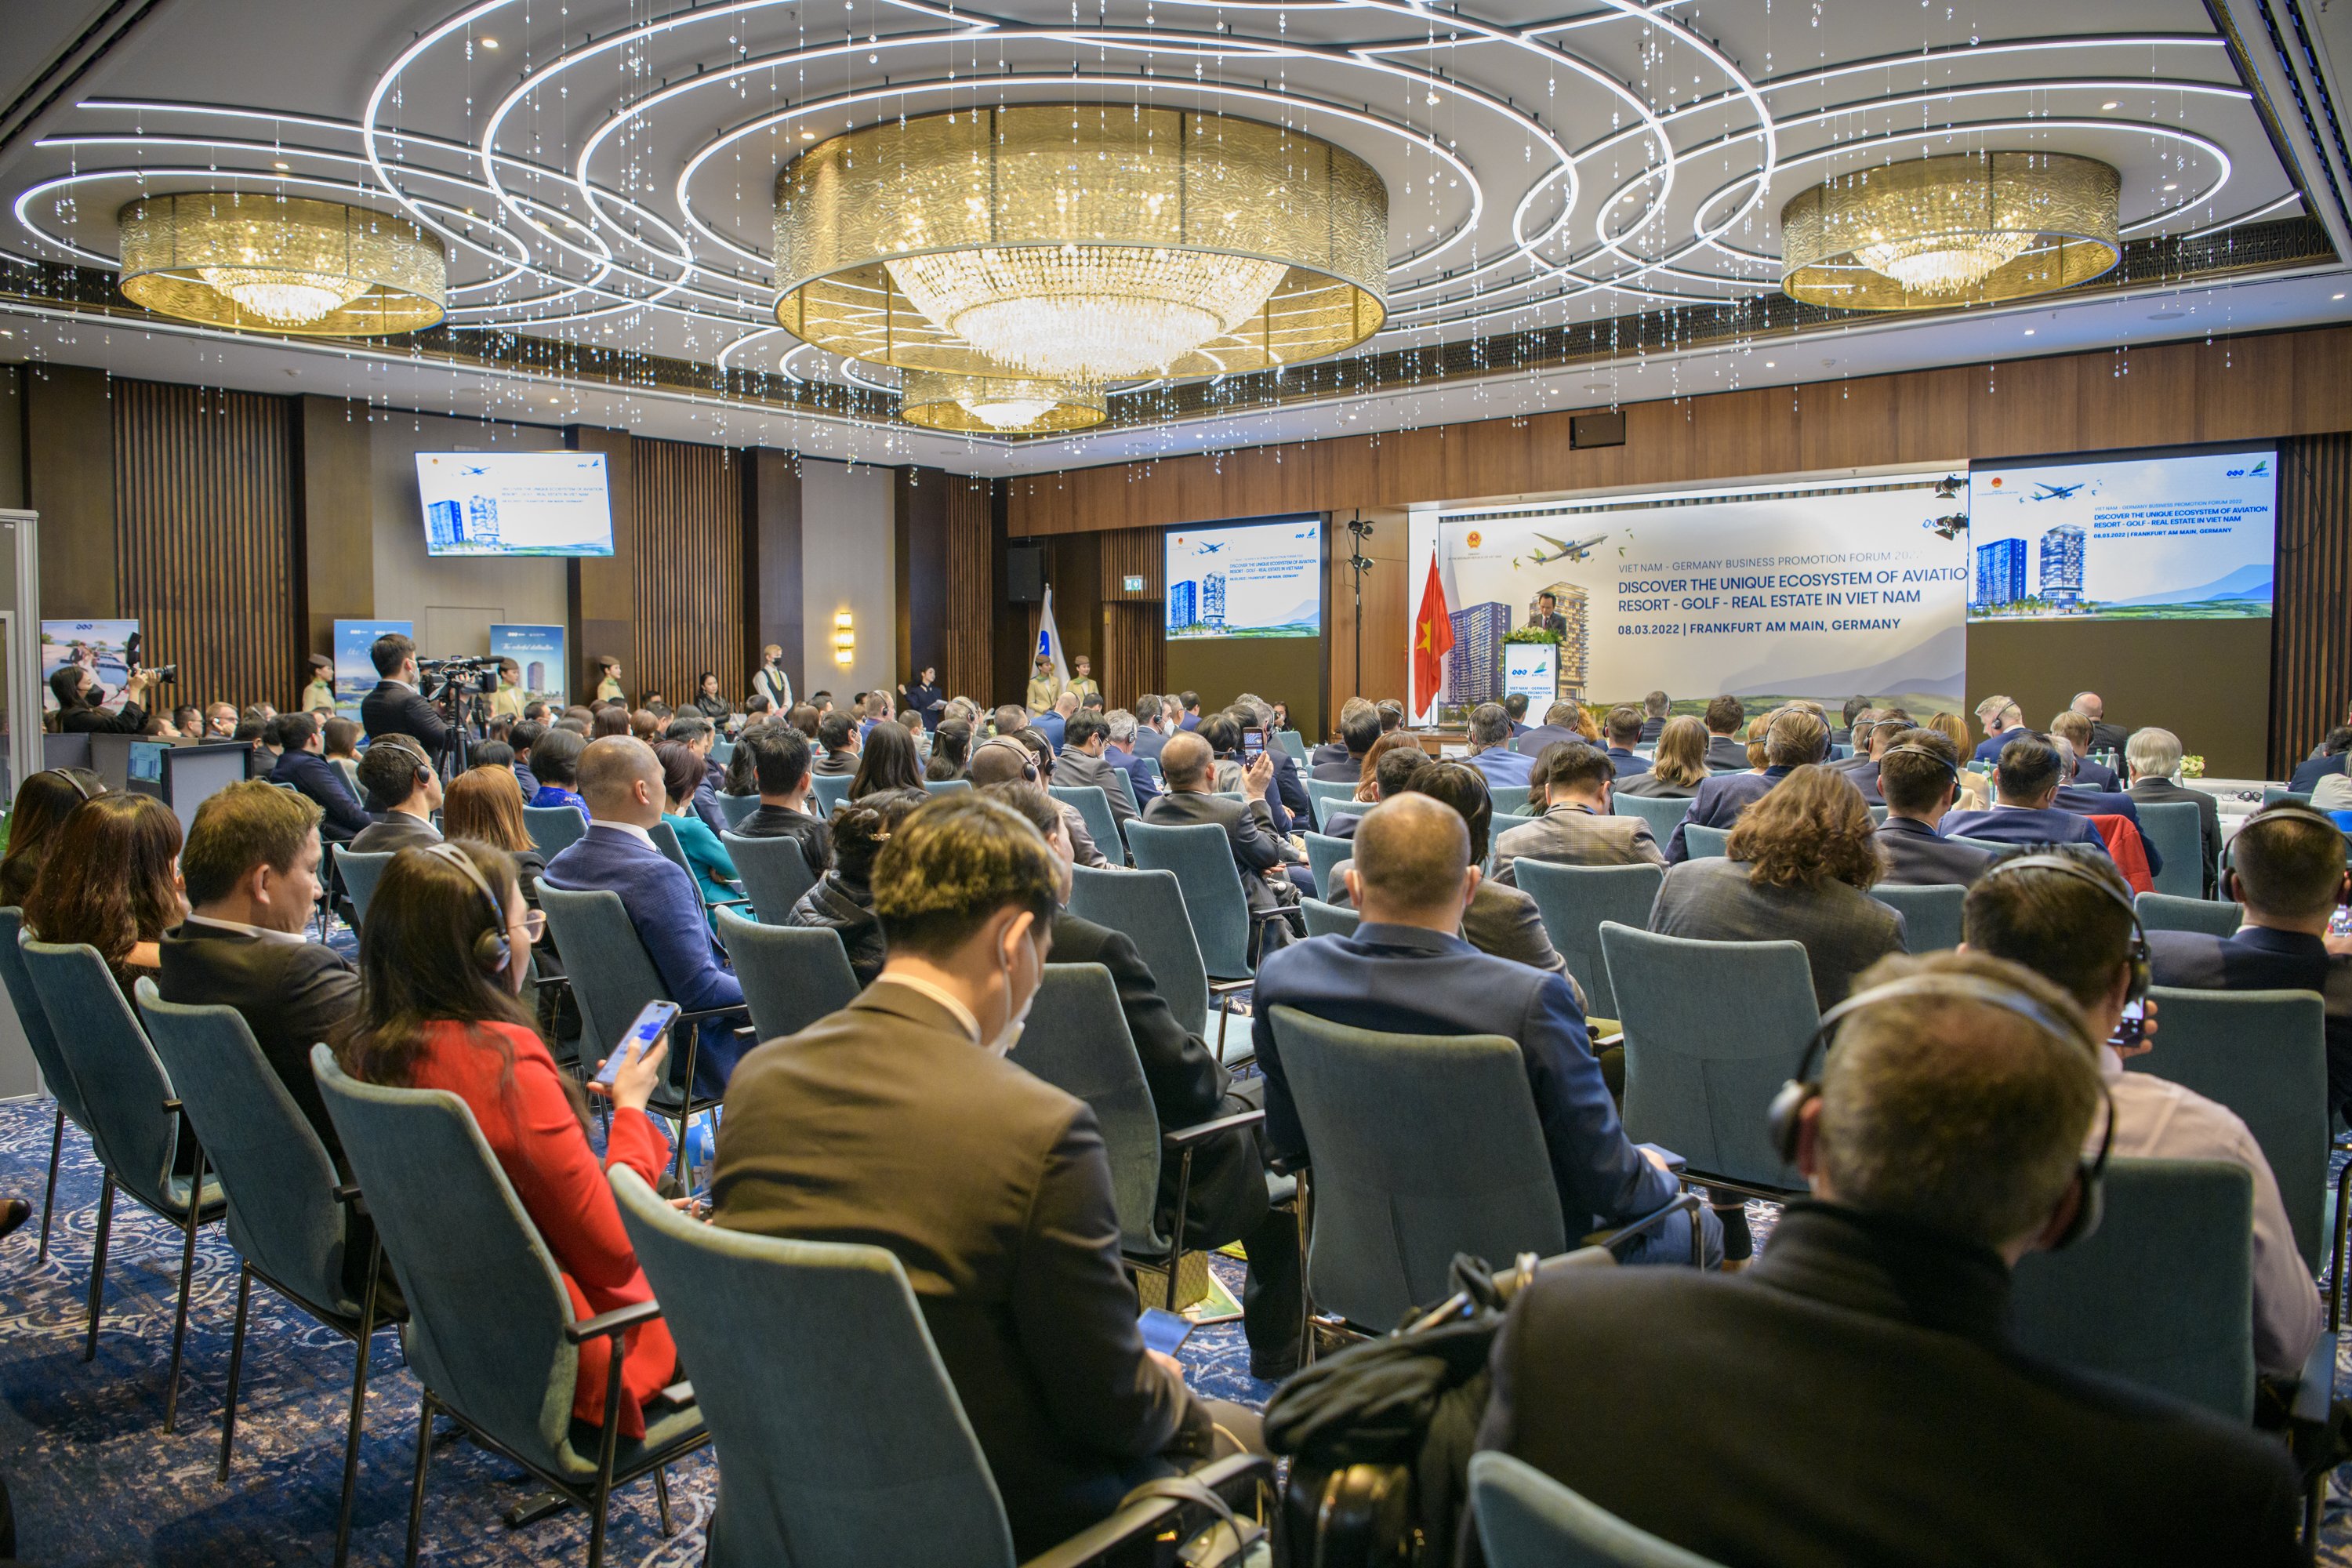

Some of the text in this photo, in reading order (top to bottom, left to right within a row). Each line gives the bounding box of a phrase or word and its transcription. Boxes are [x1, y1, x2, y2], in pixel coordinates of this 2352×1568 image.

[1619, 564, 1639, 573] VIET
[1640, 563, 1663, 572] NAM
[1672, 560, 1722, 571] GERMANY
[1726, 557, 1775, 568] BUSINESS
[1778, 554, 1846, 565] PROMOTION
[1850, 551, 1890, 562] FORUM
[1894, 550, 1922, 561] 20
[1619, 567, 1968, 593] DISCOVER THE UNIQUE ECOSYSTEM OF AVIATIO
[1619, 598, 1670, 612] RESORT
[1682, 597, 1720, 610] GOLF
[1732, 595, 1767, 608] REAL
[1770, 593, 1823, 607] ESTATE
[1827, 593, 1842, 605] IN
[1846, 591, 1878, 604] VIET
[1882, 590, 1921, 604] NAM
[1618, 624, 1679, 635] 08.03.2022
[1690, 622, 1762, 633] FRANKFURT
[1766, 622, 1786, 632] AM
[1790, 620, 1828, 633] MAIN,
[1831, 619, 1900, 630] GERMANY
